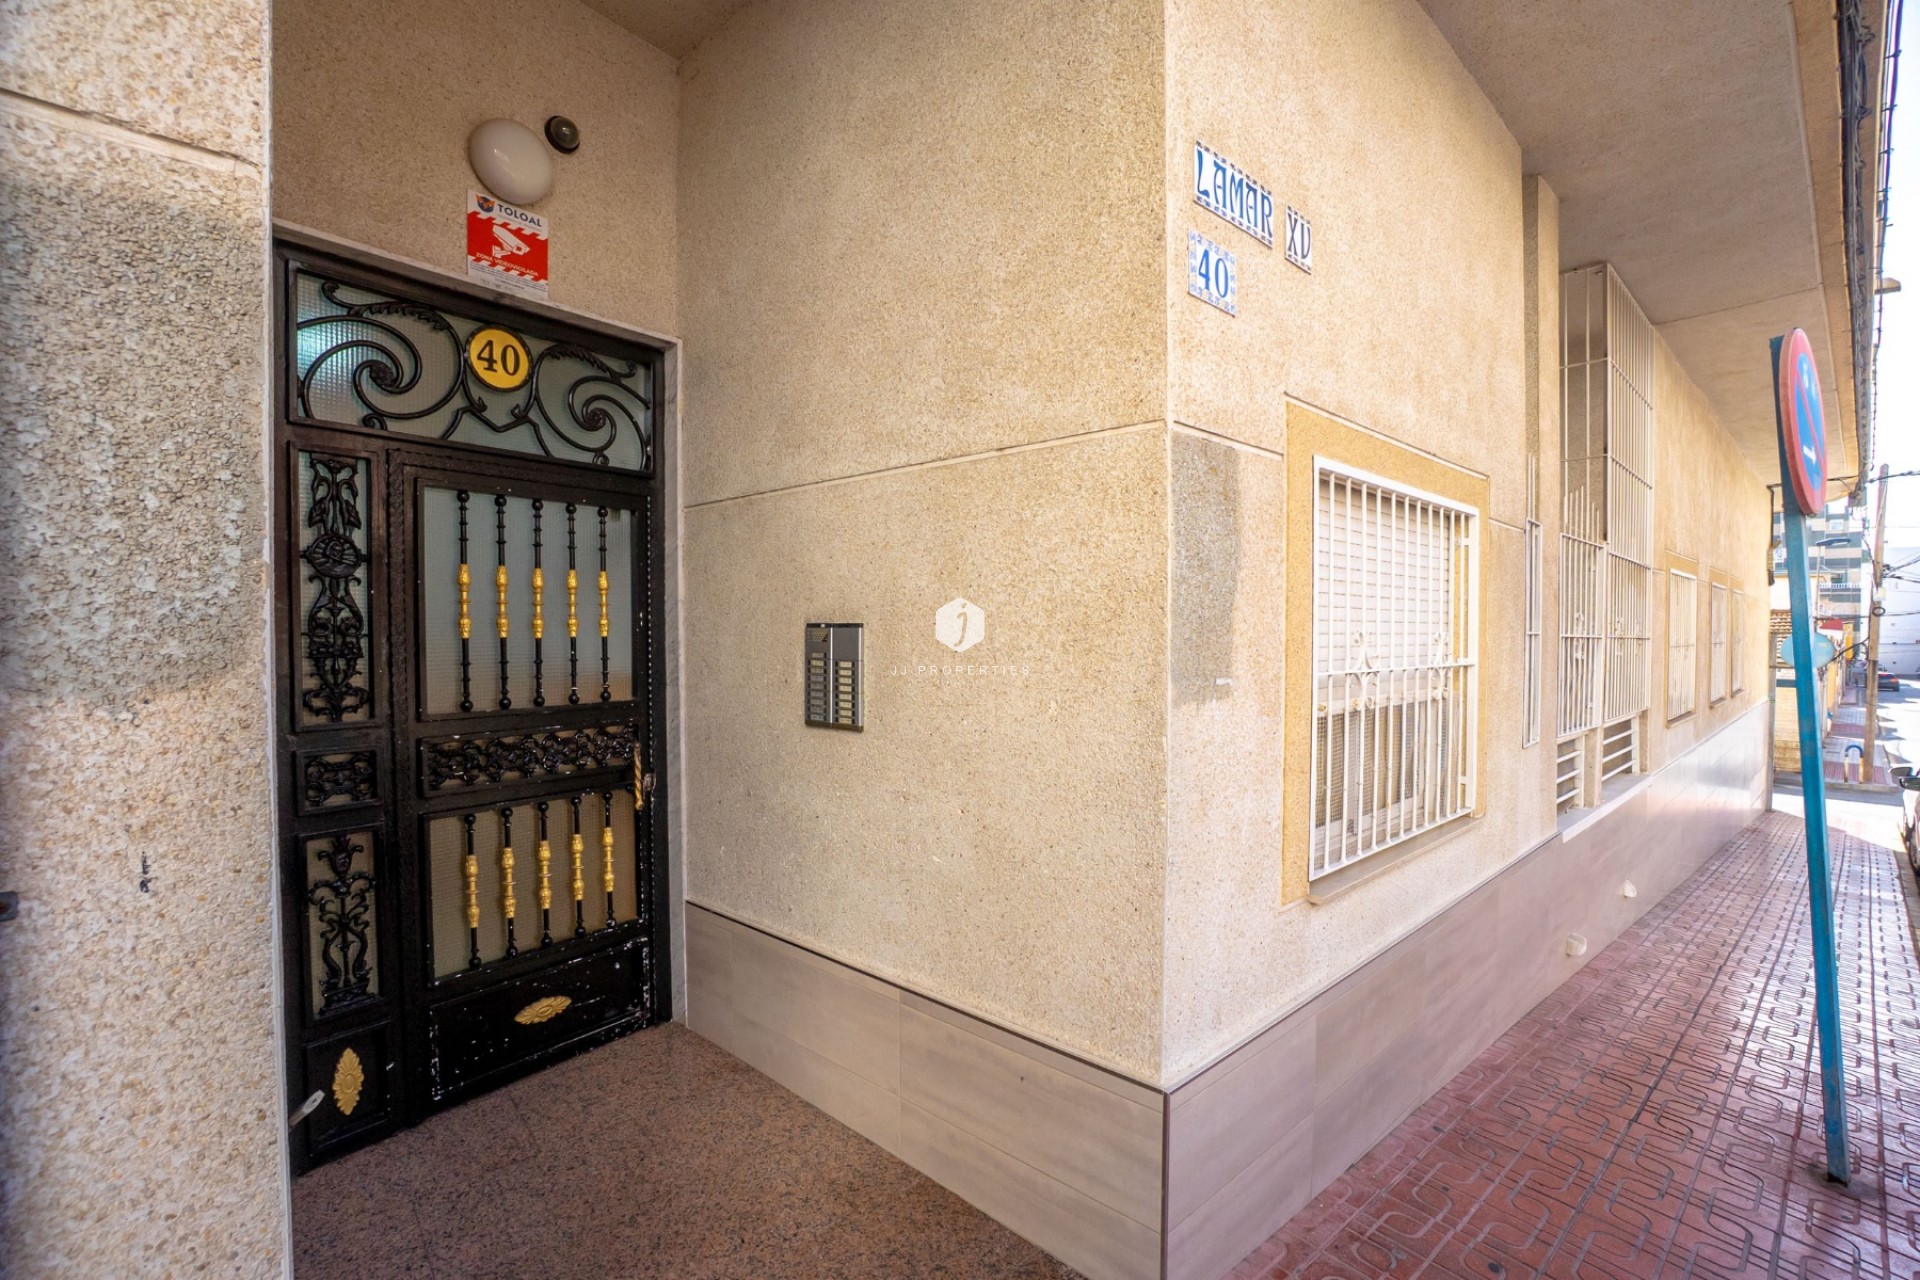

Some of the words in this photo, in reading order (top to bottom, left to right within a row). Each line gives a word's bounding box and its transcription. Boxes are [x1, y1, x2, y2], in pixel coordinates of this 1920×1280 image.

[1197, 149, 1273, 238] LAMAR
[497, 204, 542, 227] TOLOAL
[1199, 249, 1229, 298] 40
[477, 340, 520, 376] 40
